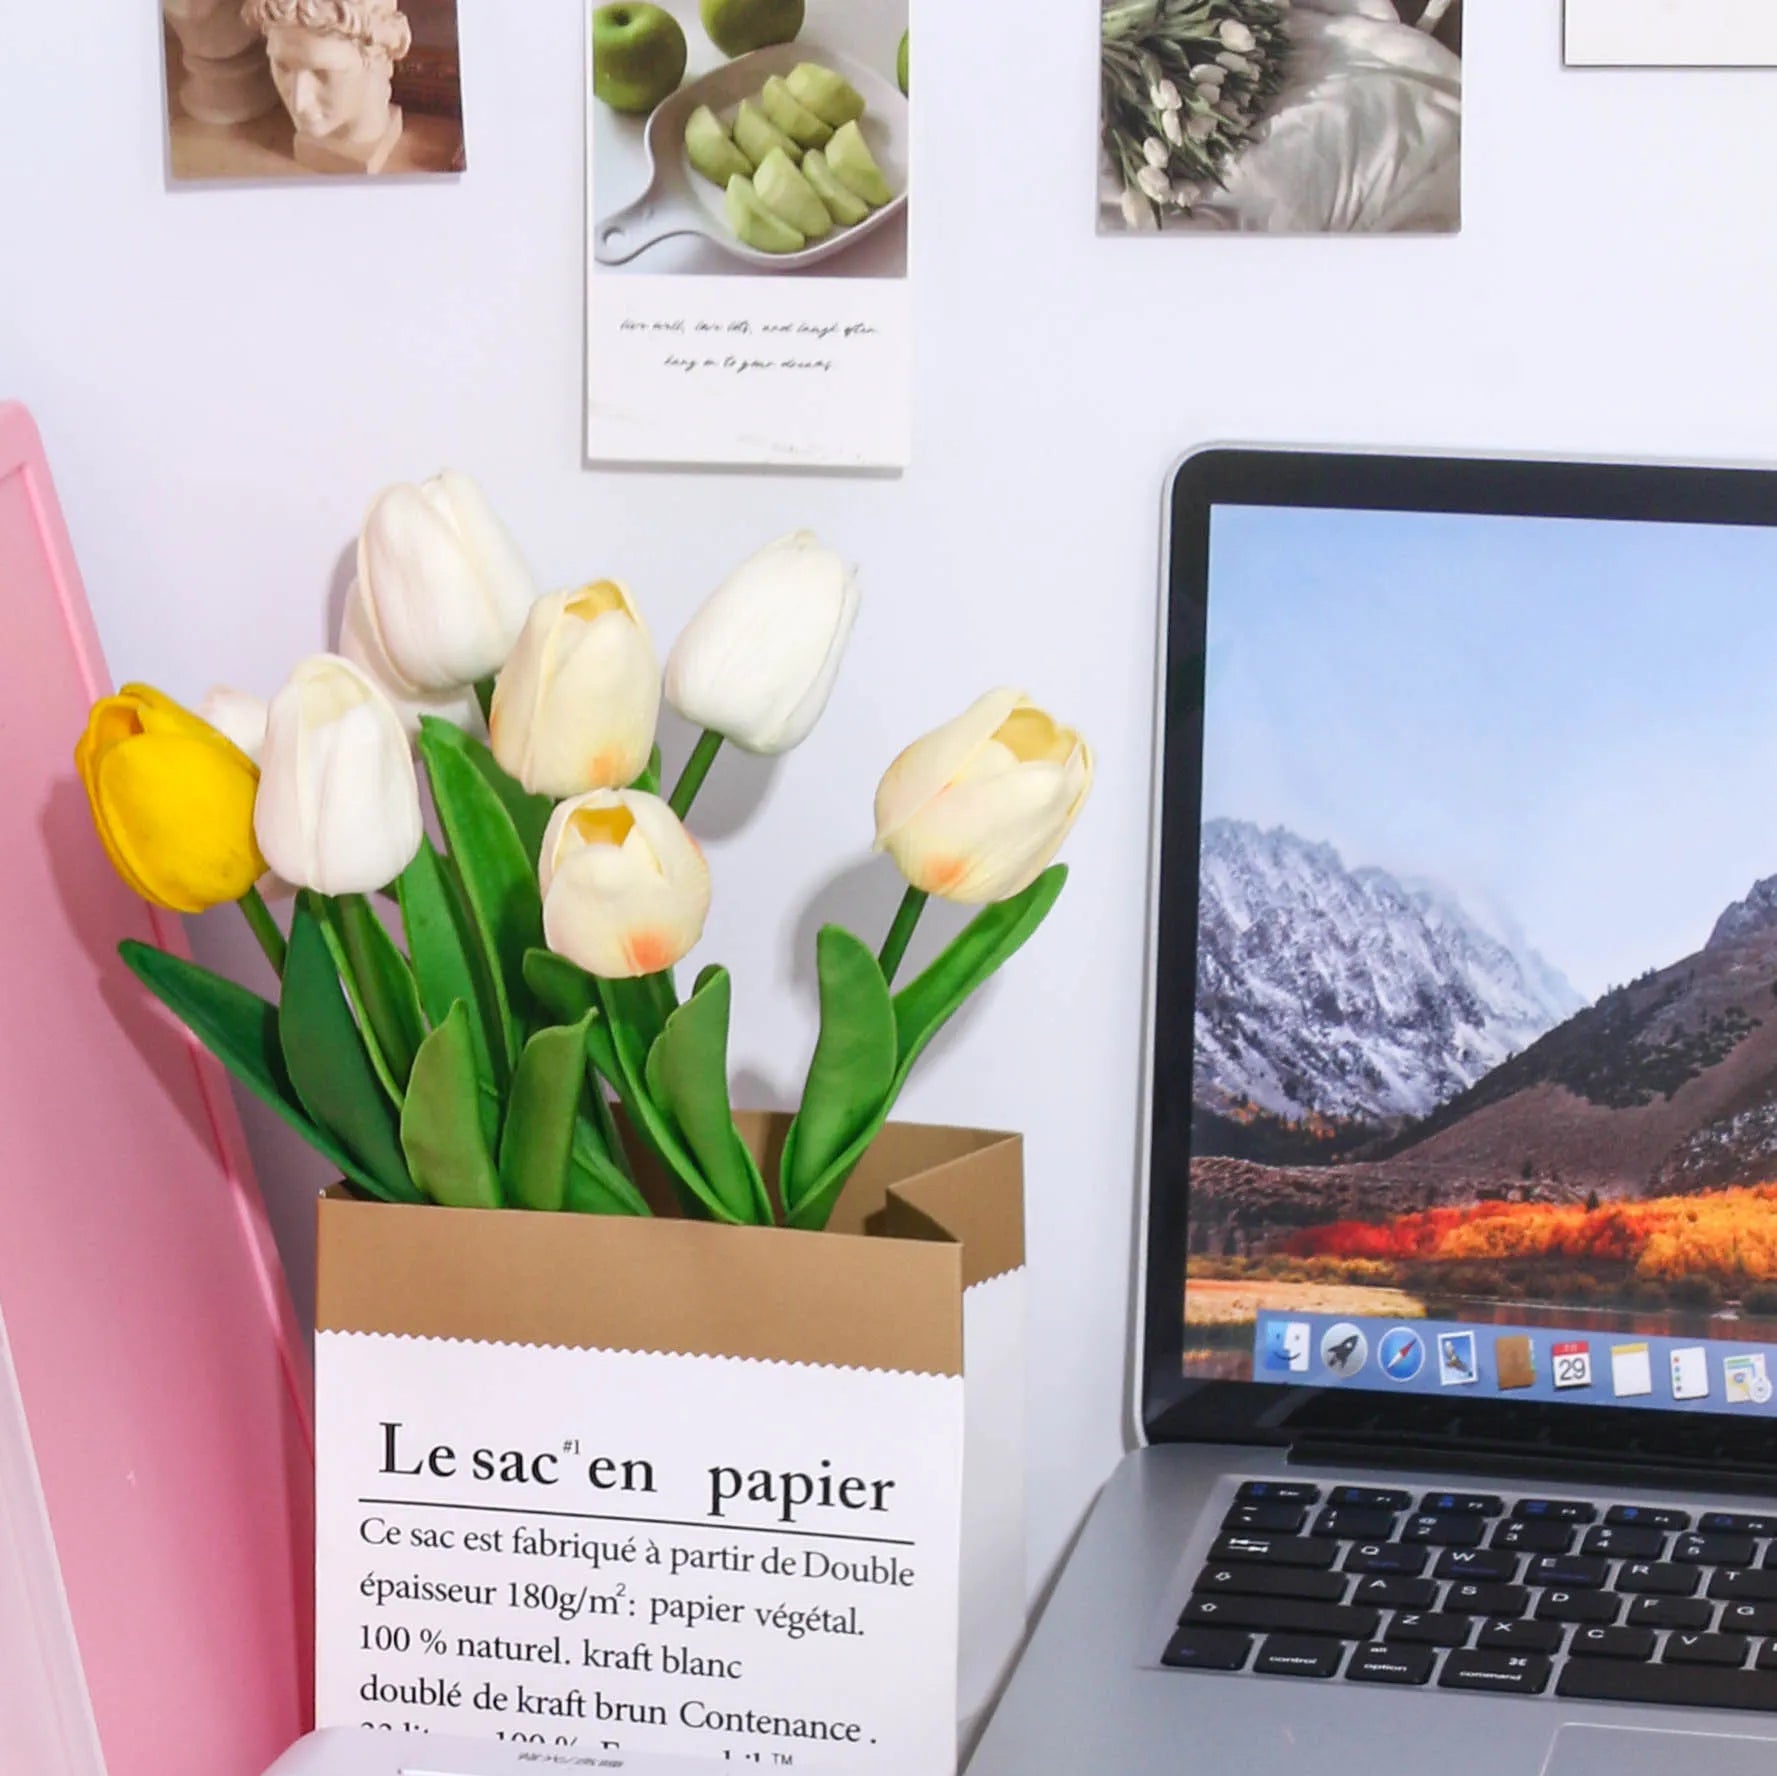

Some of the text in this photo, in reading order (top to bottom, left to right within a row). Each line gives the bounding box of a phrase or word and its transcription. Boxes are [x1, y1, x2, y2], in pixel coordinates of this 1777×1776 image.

[1559, 1358, 1586, 1381] 29
[379, 1422, 456, 1477] Le
[589, 1458, 657, 1492] en
[707, 1460, 895, 1522] papier
[360, 1518, 914, 1587] Ce sac est fabriqué à partir de Double
[1361, 1546, 1379, 1555] Q
[1453, 1552, 1475, 1561] W
[1632, 1565, 1648, 1574] R
[1727, 1572, 1739, 1580] T
[360, 1572, 497, 1606] épaisseur
[650, 1595, 745, 1628] papier
[755, 1603, 864, 1639] végétal.
[1462, 1586, 1476, 1594] S
[1552, 1593, 1569, 1601] D
[1737, 1607, 1754, 1615] G
[1403, 1615, 1697, 1644] Z X C V
[362, 1625, 742, 1679] 100 % naturel. kraft blanc
[1460, 1672, 1522, 1680] command
[360, 1674, 461, 1707] doublé
[473, 1682, 508, 1711] de
[517, 1685, 586, 1718] kraft
[595, 1692, 667, 1725] brun
